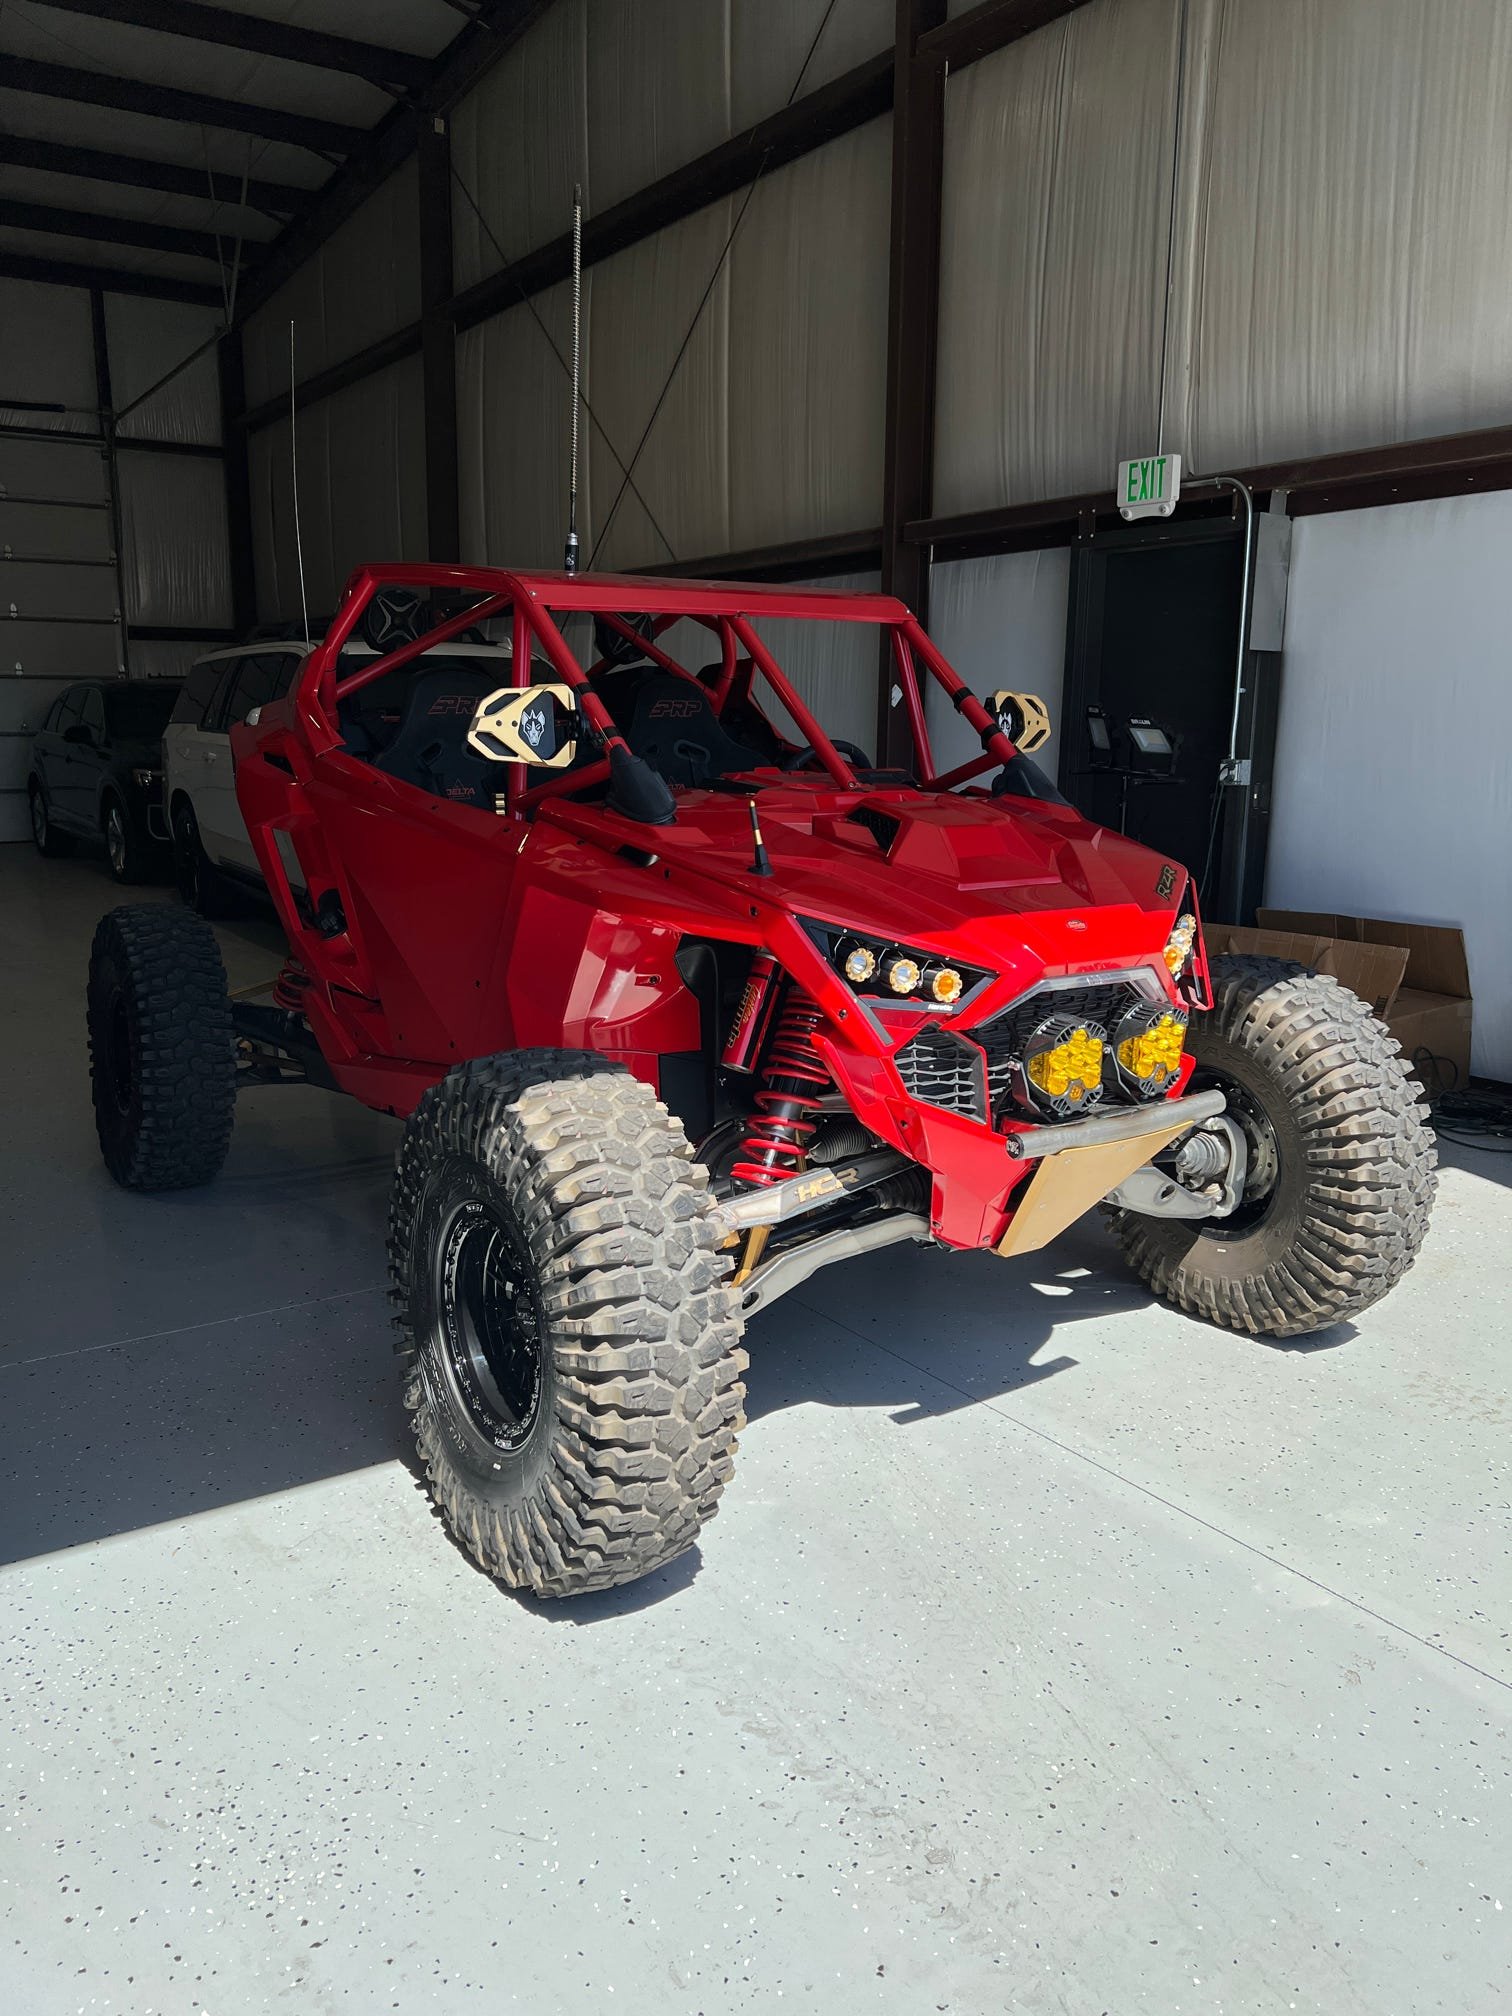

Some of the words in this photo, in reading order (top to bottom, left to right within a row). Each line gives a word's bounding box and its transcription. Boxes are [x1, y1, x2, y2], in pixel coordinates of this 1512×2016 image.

[1127, 458, 1166, 502] EXIT
[648, 700, 702, 718] PRP
[1157, 865, 1176, 901] RZR
[796, 1167, 861, 1203] HCR
